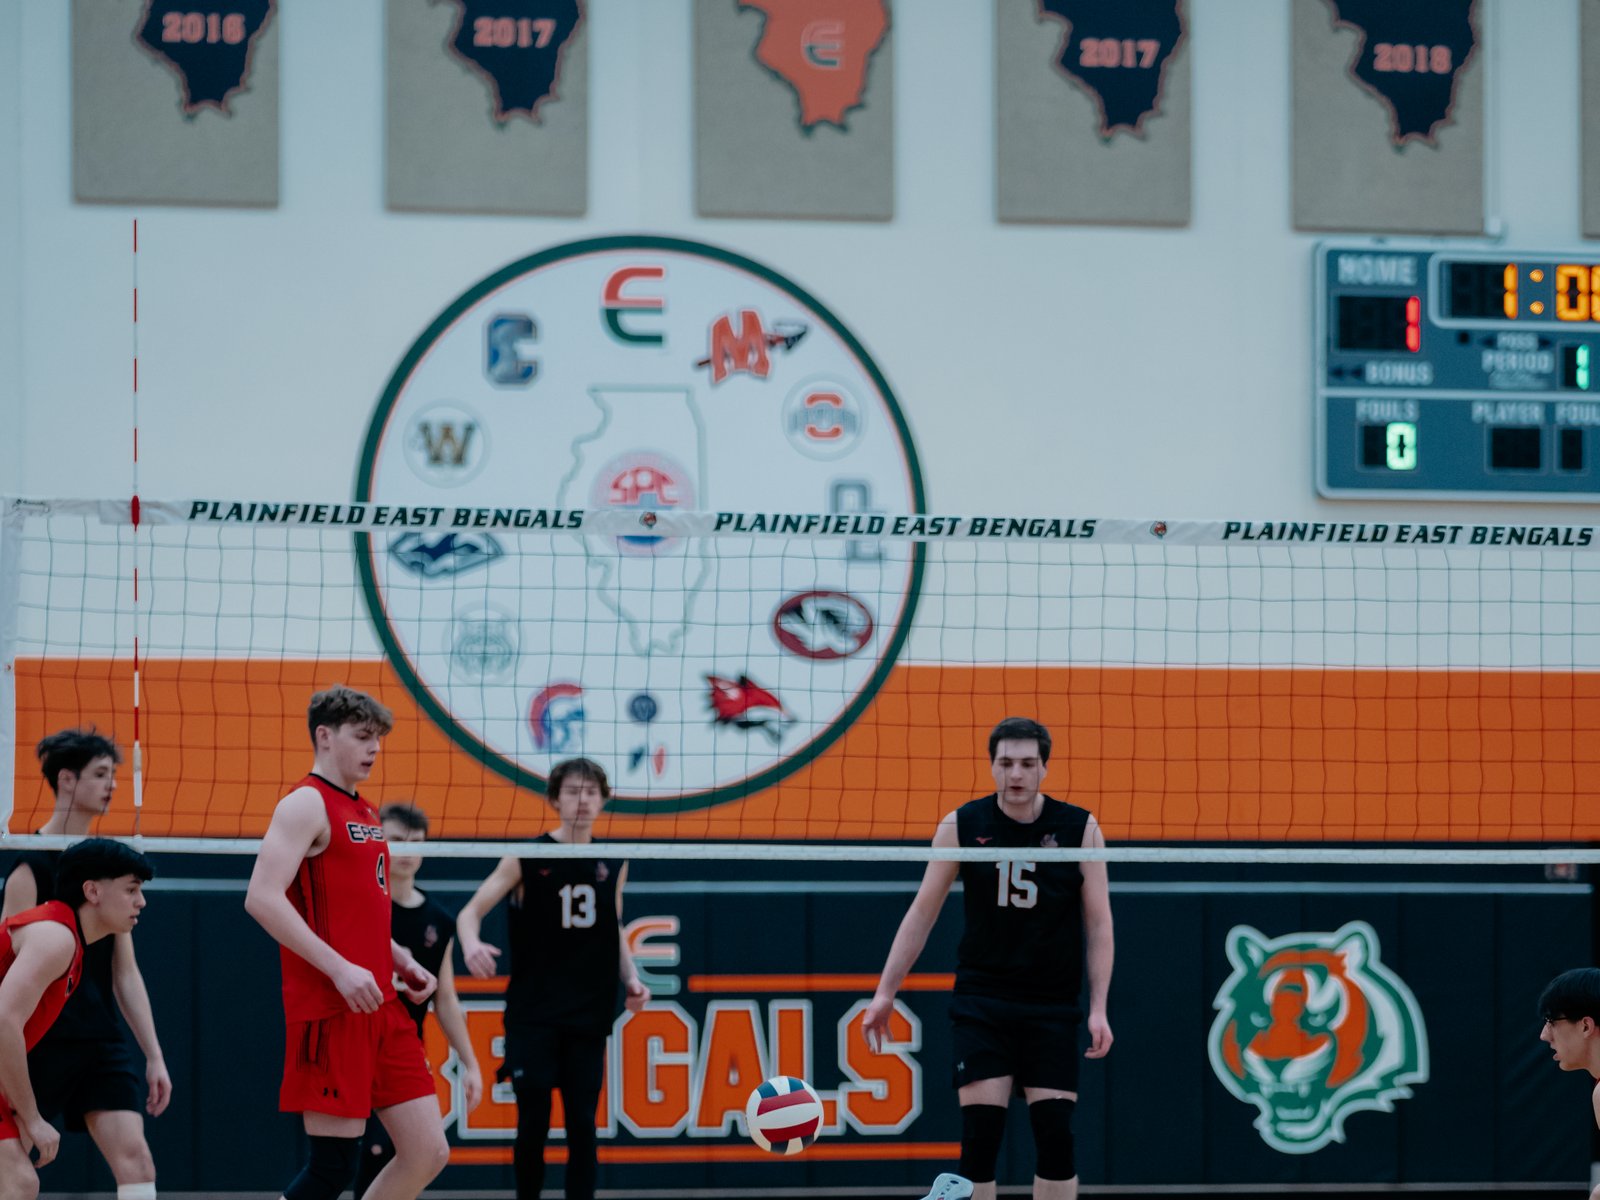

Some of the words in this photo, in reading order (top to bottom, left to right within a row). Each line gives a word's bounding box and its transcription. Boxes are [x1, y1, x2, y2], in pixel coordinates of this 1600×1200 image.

[473, 18, 556, 48] 2017
[1079, 39, 1161, 69] 2017
[1338, 254, 1418, 284] HOME
[1503, 263, 1600, 321] 1:0
[1406, 296, 1421, 352] 1
[1365, 361, 1433, 384] BONUS
[1482, 350, 1554, 373] PERIOD
[1576, 344, 1590, 390] 1
[1356, 400, 1419, 422] FOULS
[1472, 401, 1545, 423] PLAYER
[1386, 422, 1417, 470] 0
[188, 501, 366, 524] PLAINFIELD
[372, 506, 445, 526] EAST
[451, 508, 584, 529] BENGALS
[714, 513, 885, 535] PLAINFIELD
[891, 516, 962, 536] EAST
[968, 517, 1097, 538] BENGALS
[1223, 521, 1389, 543] PLAINFIELD
[1394, 524, 1463, 544] EAST
[1469, 526, 1593, 546] BENGALS
[346, 822, 385, 843] EAS
[995, 859, 1038, 909] 15
[559, 884, 596, 928] 13
